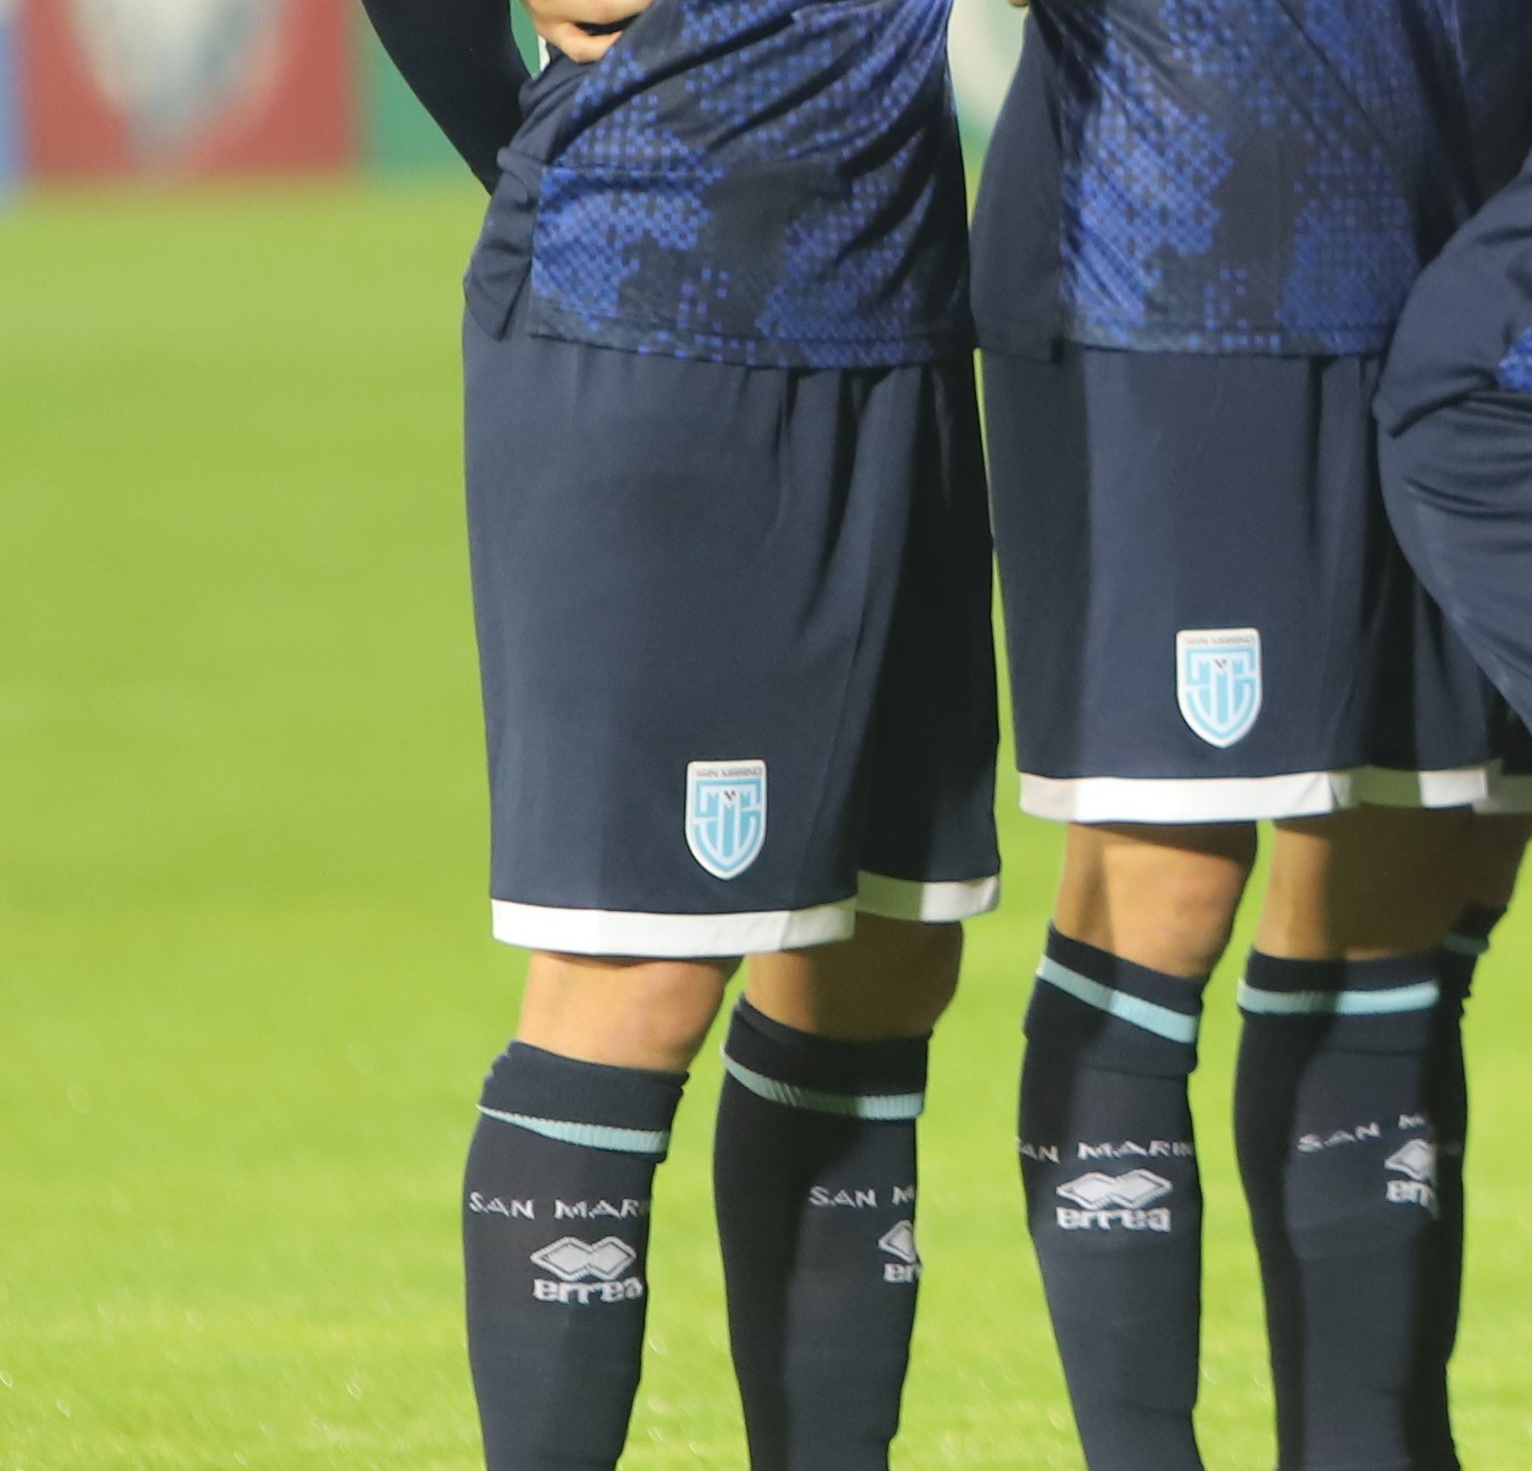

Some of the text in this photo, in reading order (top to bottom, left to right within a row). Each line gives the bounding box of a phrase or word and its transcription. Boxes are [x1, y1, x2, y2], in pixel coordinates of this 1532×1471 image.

[1297, 1122, 1381, 1152] SAN
[469, 1191, 535, 1219] SAN
[808, 1186, 878, 1208] SAN
[1056, 1206, 1172, 1233] errea
[533, 1276, 643, 1304] errea
